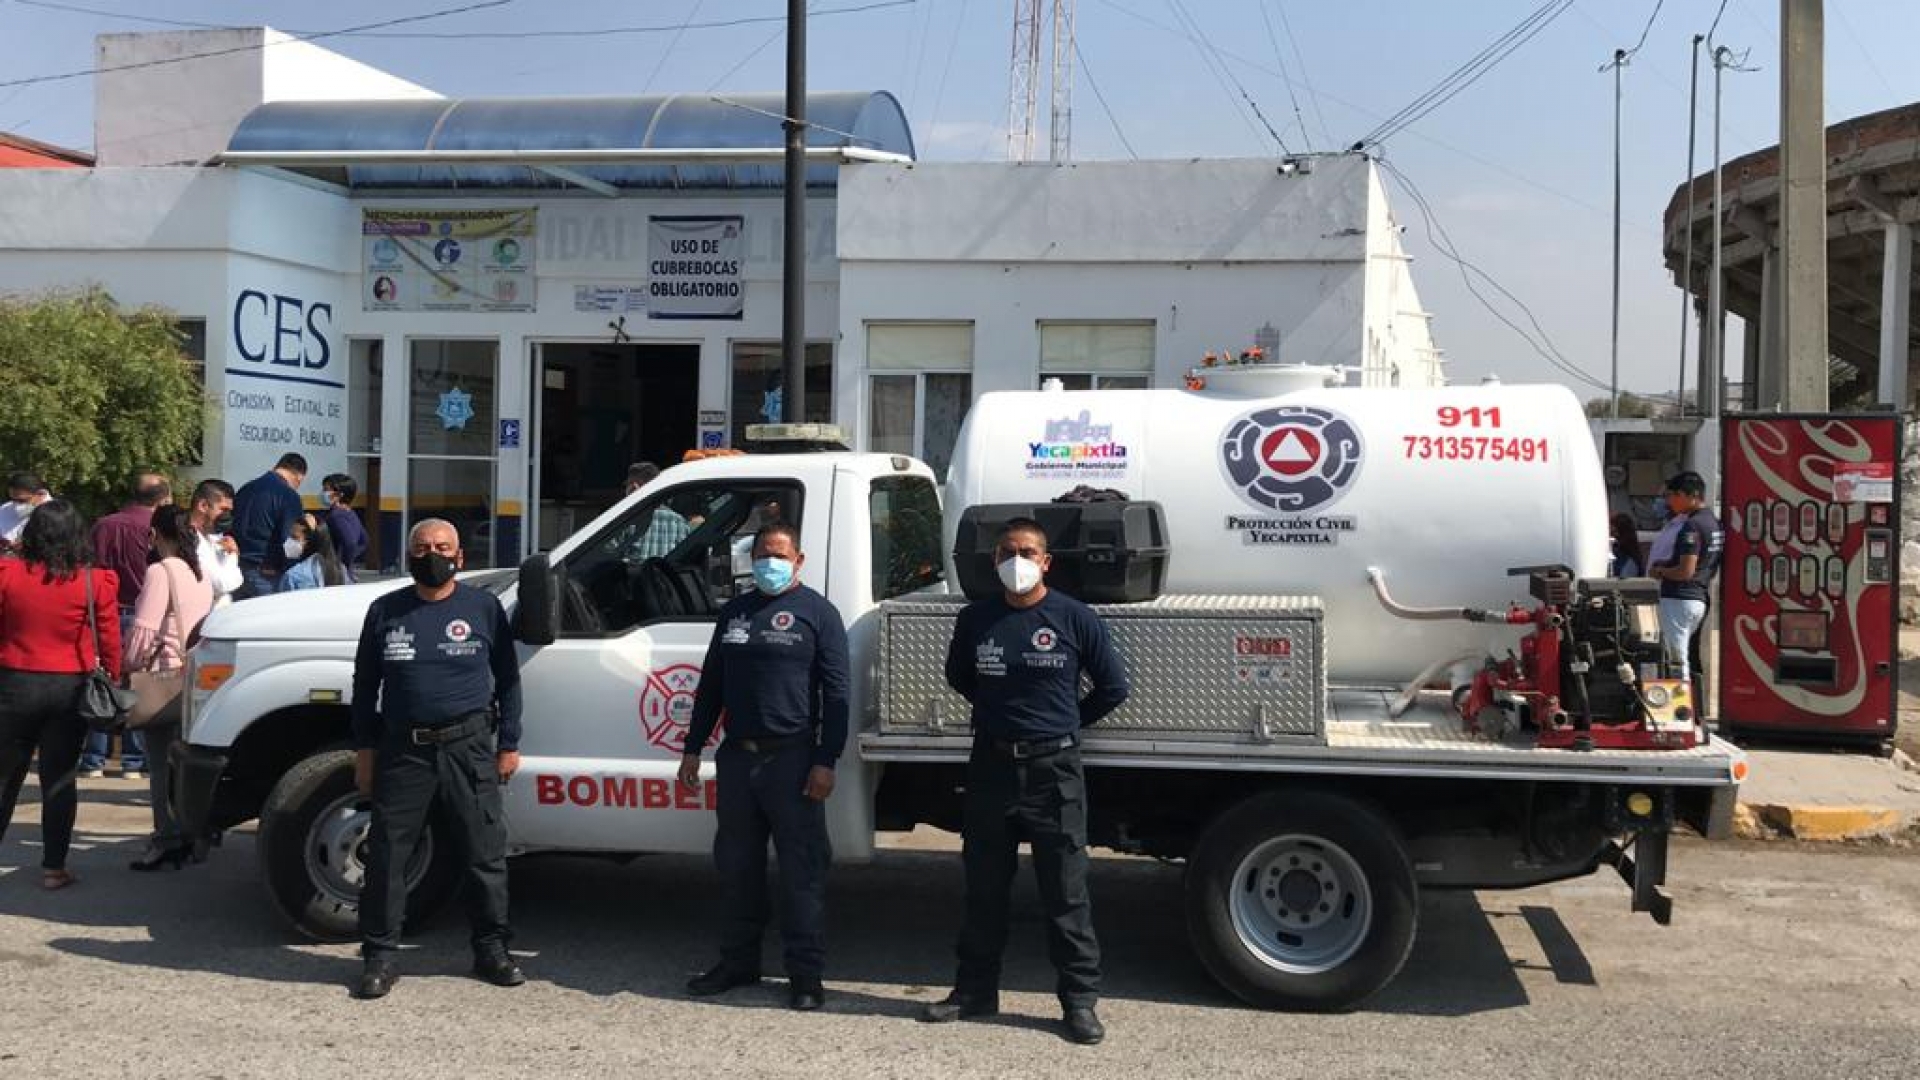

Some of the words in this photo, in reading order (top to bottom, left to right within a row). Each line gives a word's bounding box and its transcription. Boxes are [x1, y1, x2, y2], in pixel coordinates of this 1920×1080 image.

[671, 240, 698, 254] USO
[702, 240, 719, 254] DE
[652, 260, 738, 275] CUBREBOCAS
[650, 282, 739, 297] OBLIGATORIO
[234, 289, 332, 369] CES
[1437, 406, 1501, 428] 911
[1029, 442, 1127, 461] Yecapixtla
[1404, 436, 1548, 462] 7313575491
[1076, 462, 1127, 471] Municipal
